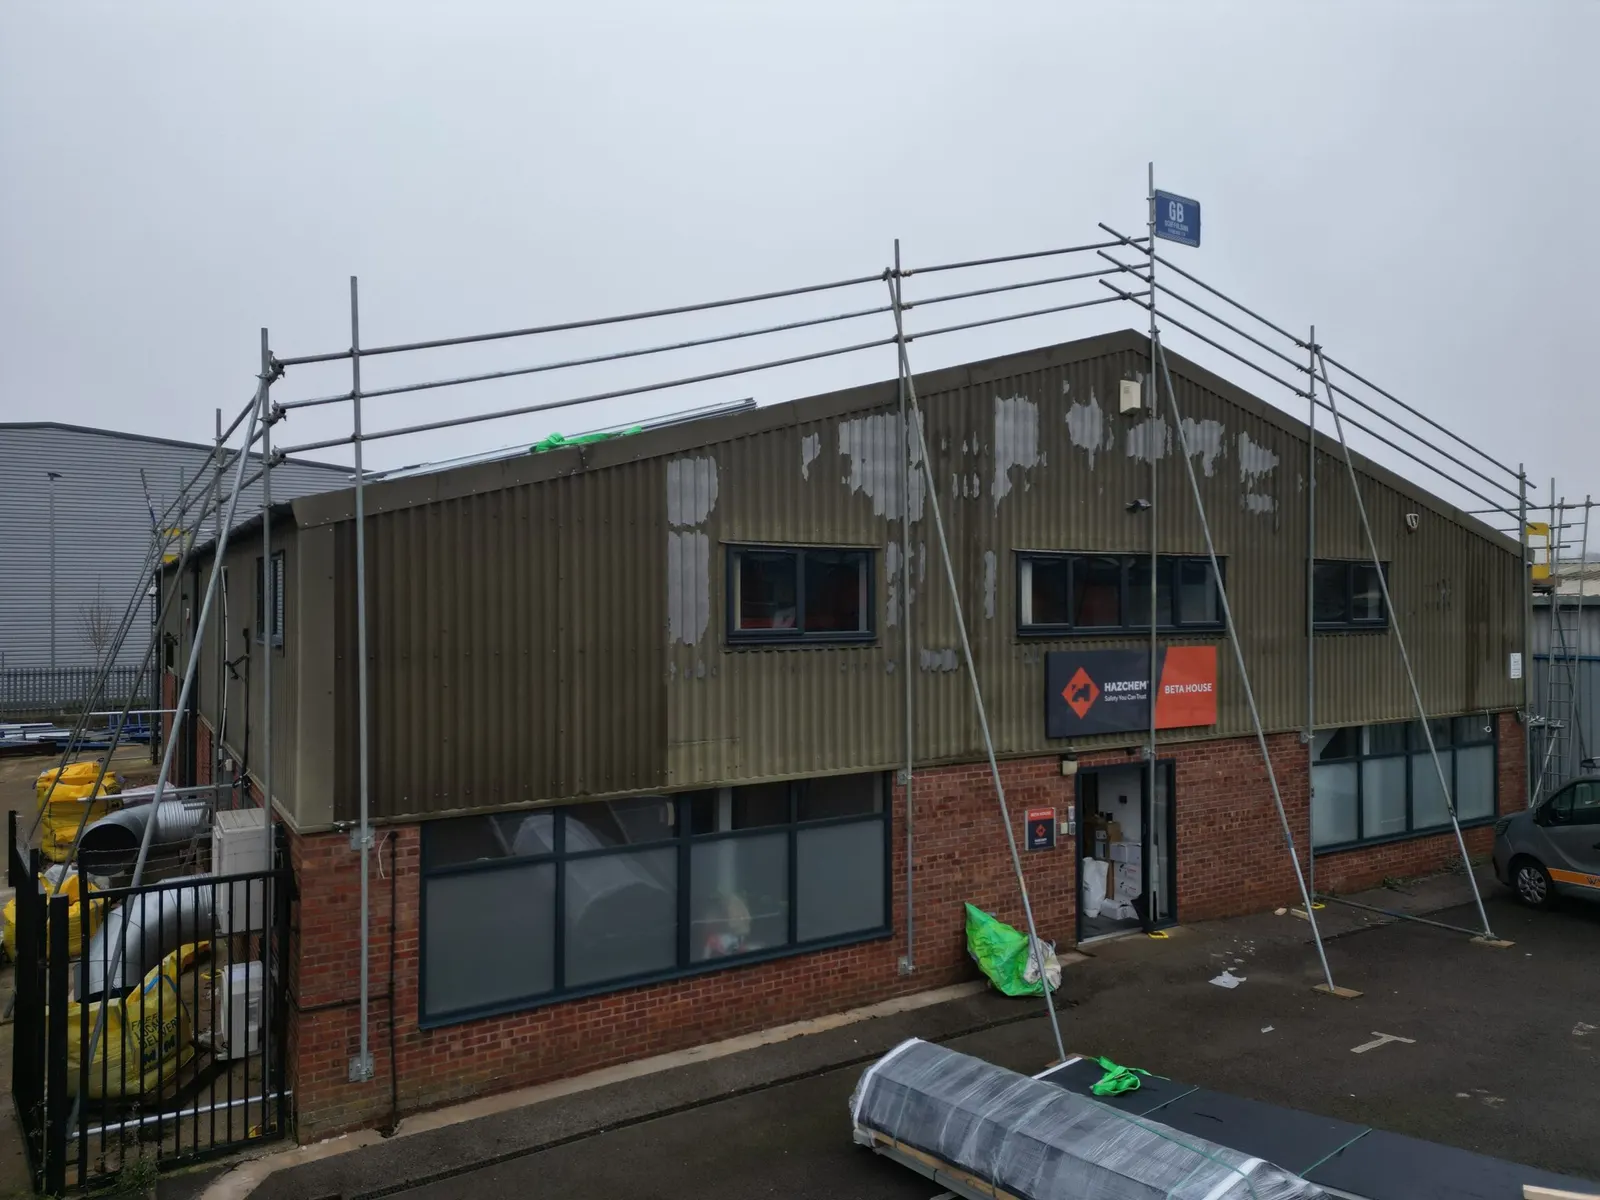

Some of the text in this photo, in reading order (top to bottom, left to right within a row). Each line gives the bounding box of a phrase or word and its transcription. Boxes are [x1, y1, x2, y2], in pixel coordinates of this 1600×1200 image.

[1169, 201, 1184, 223] GB
[1104, 680, 1147, 692] HAZCHEM
[1164, 682, 1212, 694] BETA HOUSE
[1104, 694, 1118, 703] Safety
[131, 1012, 160, 1031] FEE
[139, 1016, 181, 1049] DELVER
